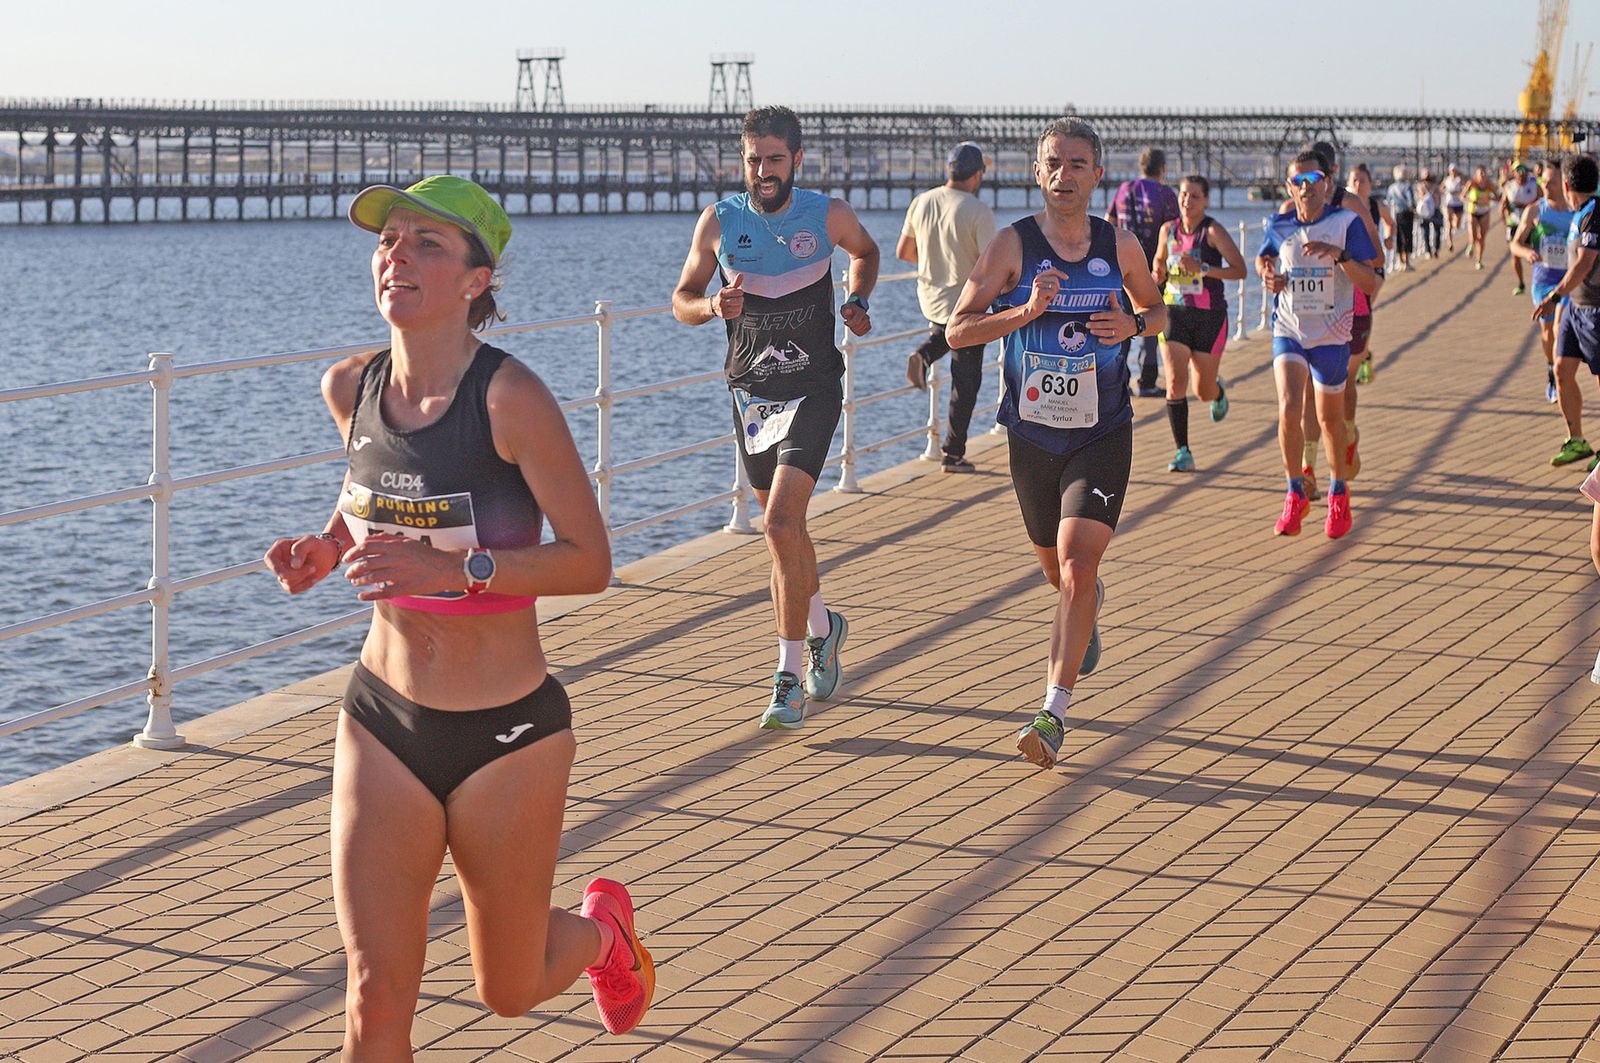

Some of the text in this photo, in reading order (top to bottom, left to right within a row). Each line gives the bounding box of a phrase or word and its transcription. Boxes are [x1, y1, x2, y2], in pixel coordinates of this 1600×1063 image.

[1291, 279, 1324, 293] 1101
[1041, 374, 1079, 397] 630
[1052, 414, 1073, 422] Syrluz
[376, 497, 451, 514] RUNNING
[395, 514, 439, 527] LOOP
